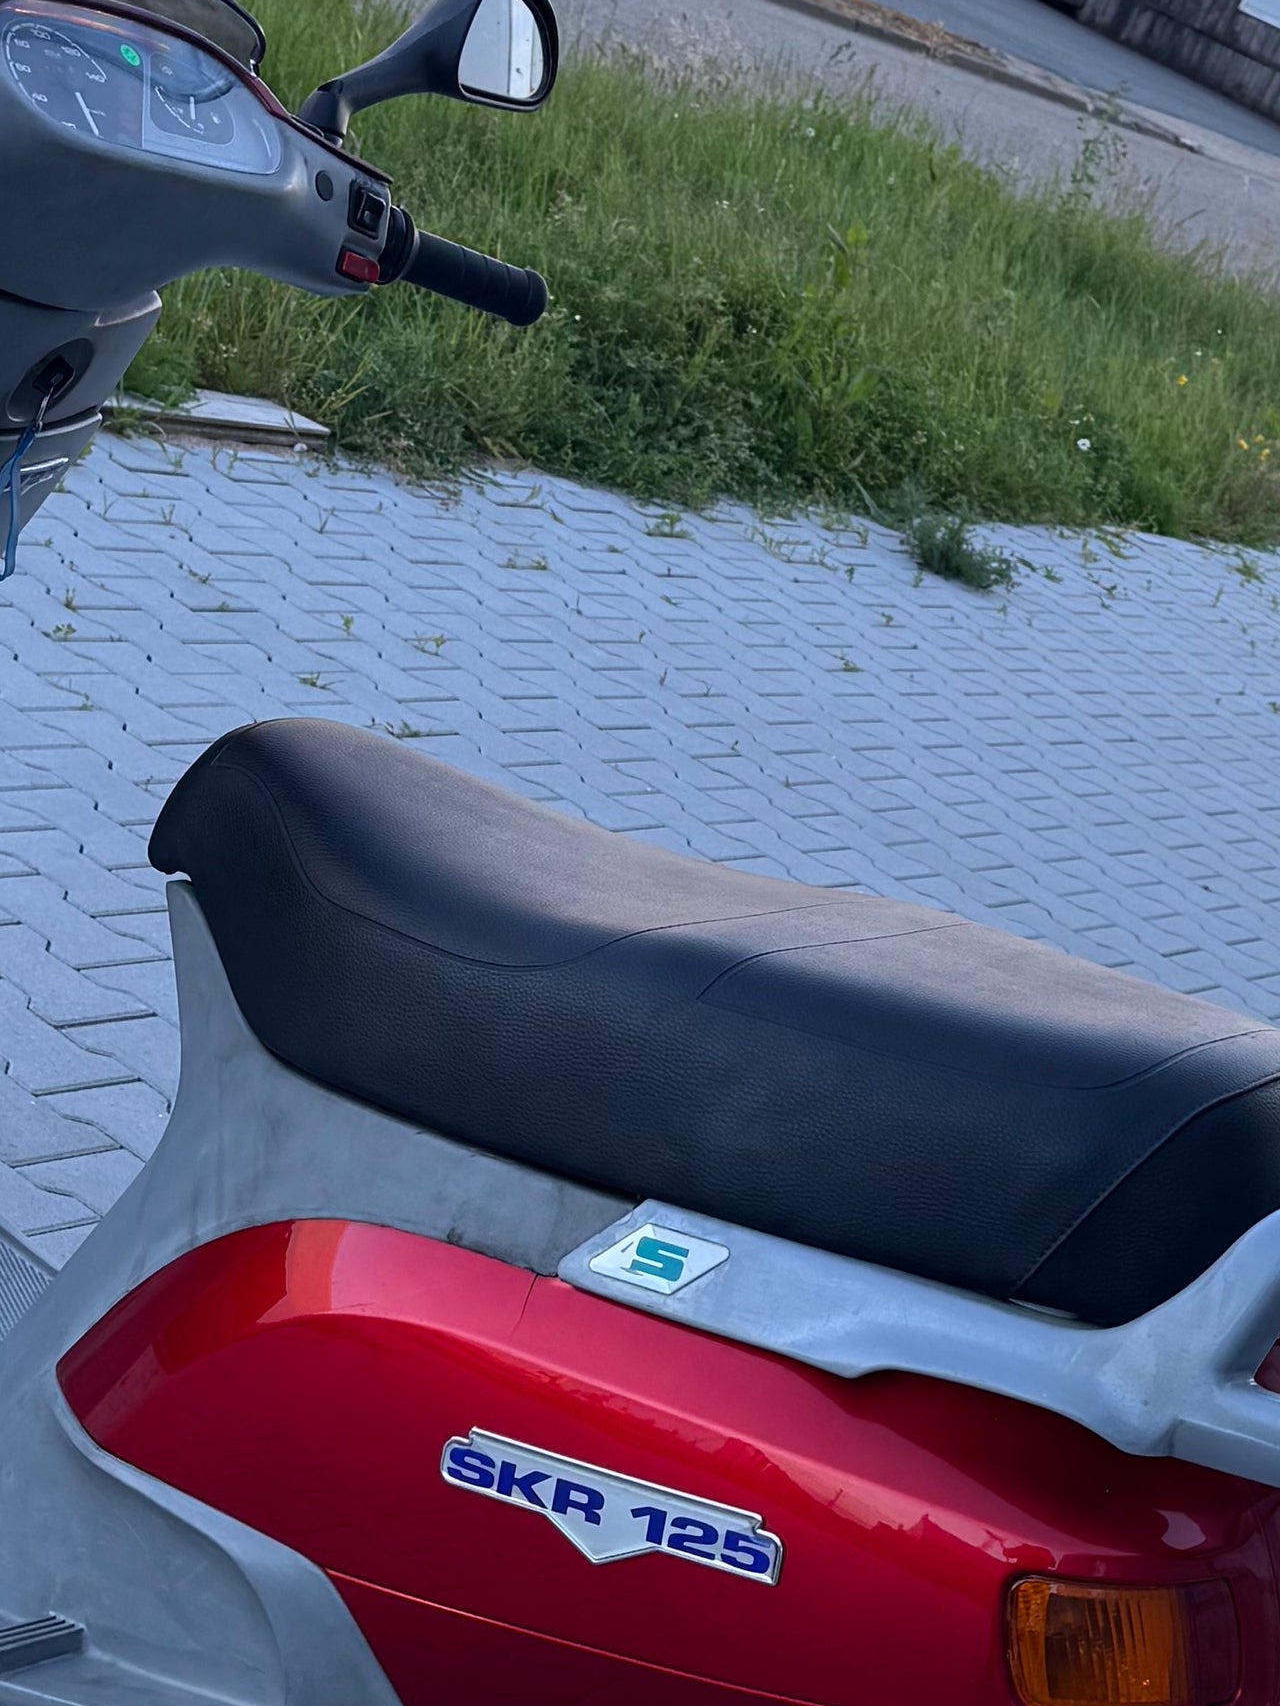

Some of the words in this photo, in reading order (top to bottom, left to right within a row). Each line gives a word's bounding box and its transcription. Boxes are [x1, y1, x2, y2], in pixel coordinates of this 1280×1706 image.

[628, 1235, 691, 1283] S
[446, 1447, 606, 1527] SKR
[630, 1505, 771, 1575] 125
